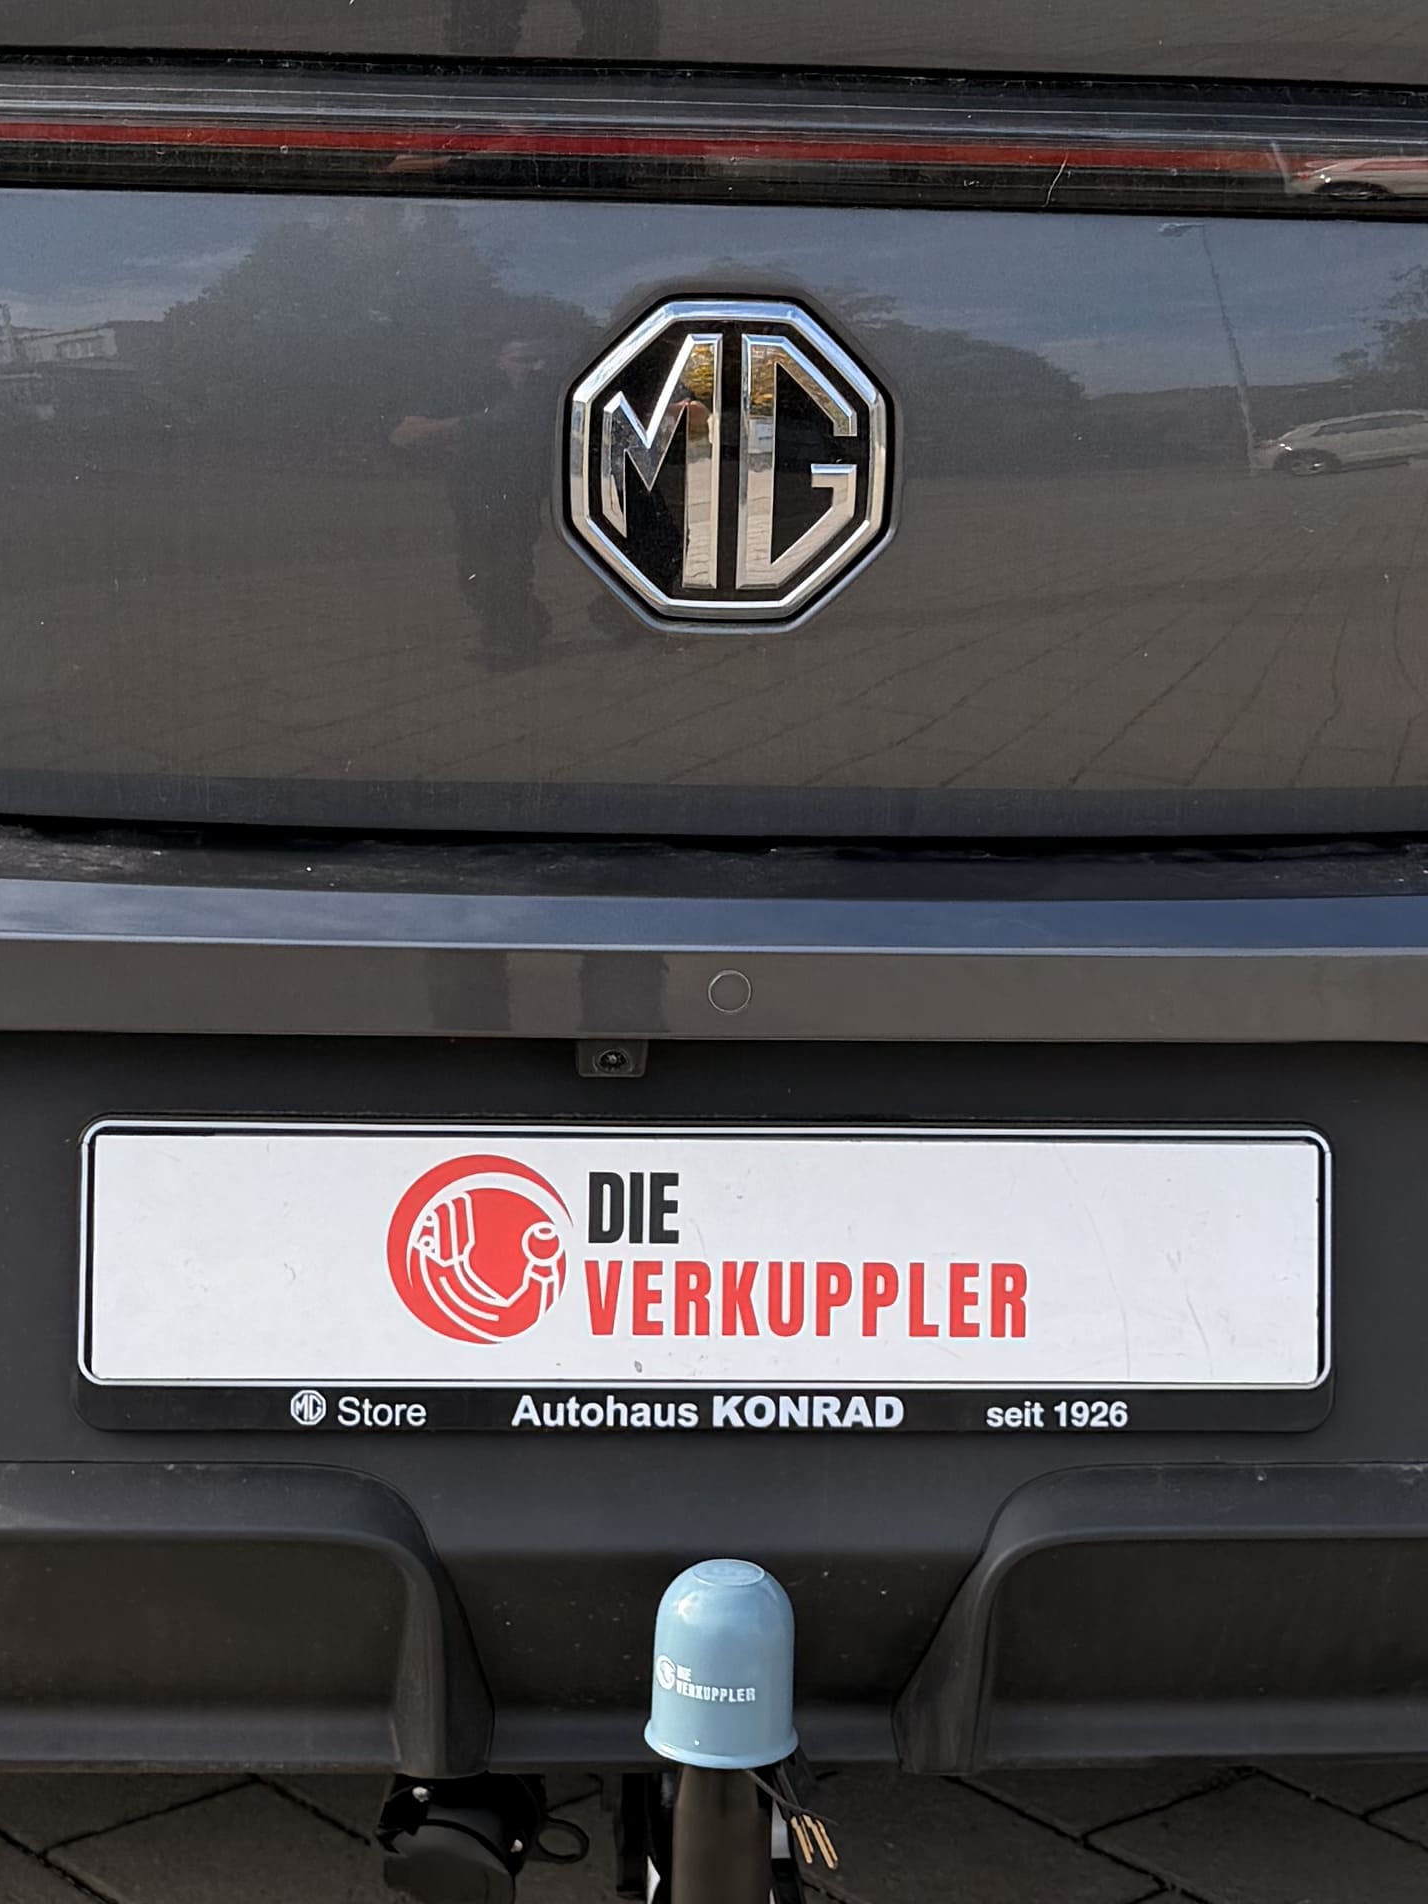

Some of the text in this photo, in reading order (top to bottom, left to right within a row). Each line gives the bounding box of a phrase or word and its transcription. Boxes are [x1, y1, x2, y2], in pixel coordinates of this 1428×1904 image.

[600, 333, 858, 590] MG
[587, 1171, 680, 1244] DIE
[584, 1260, 1028, 1338] VERKUPPLER
[294, 1393, 1129, 1428] MG Store Autohaus KONRAD seit 1926
